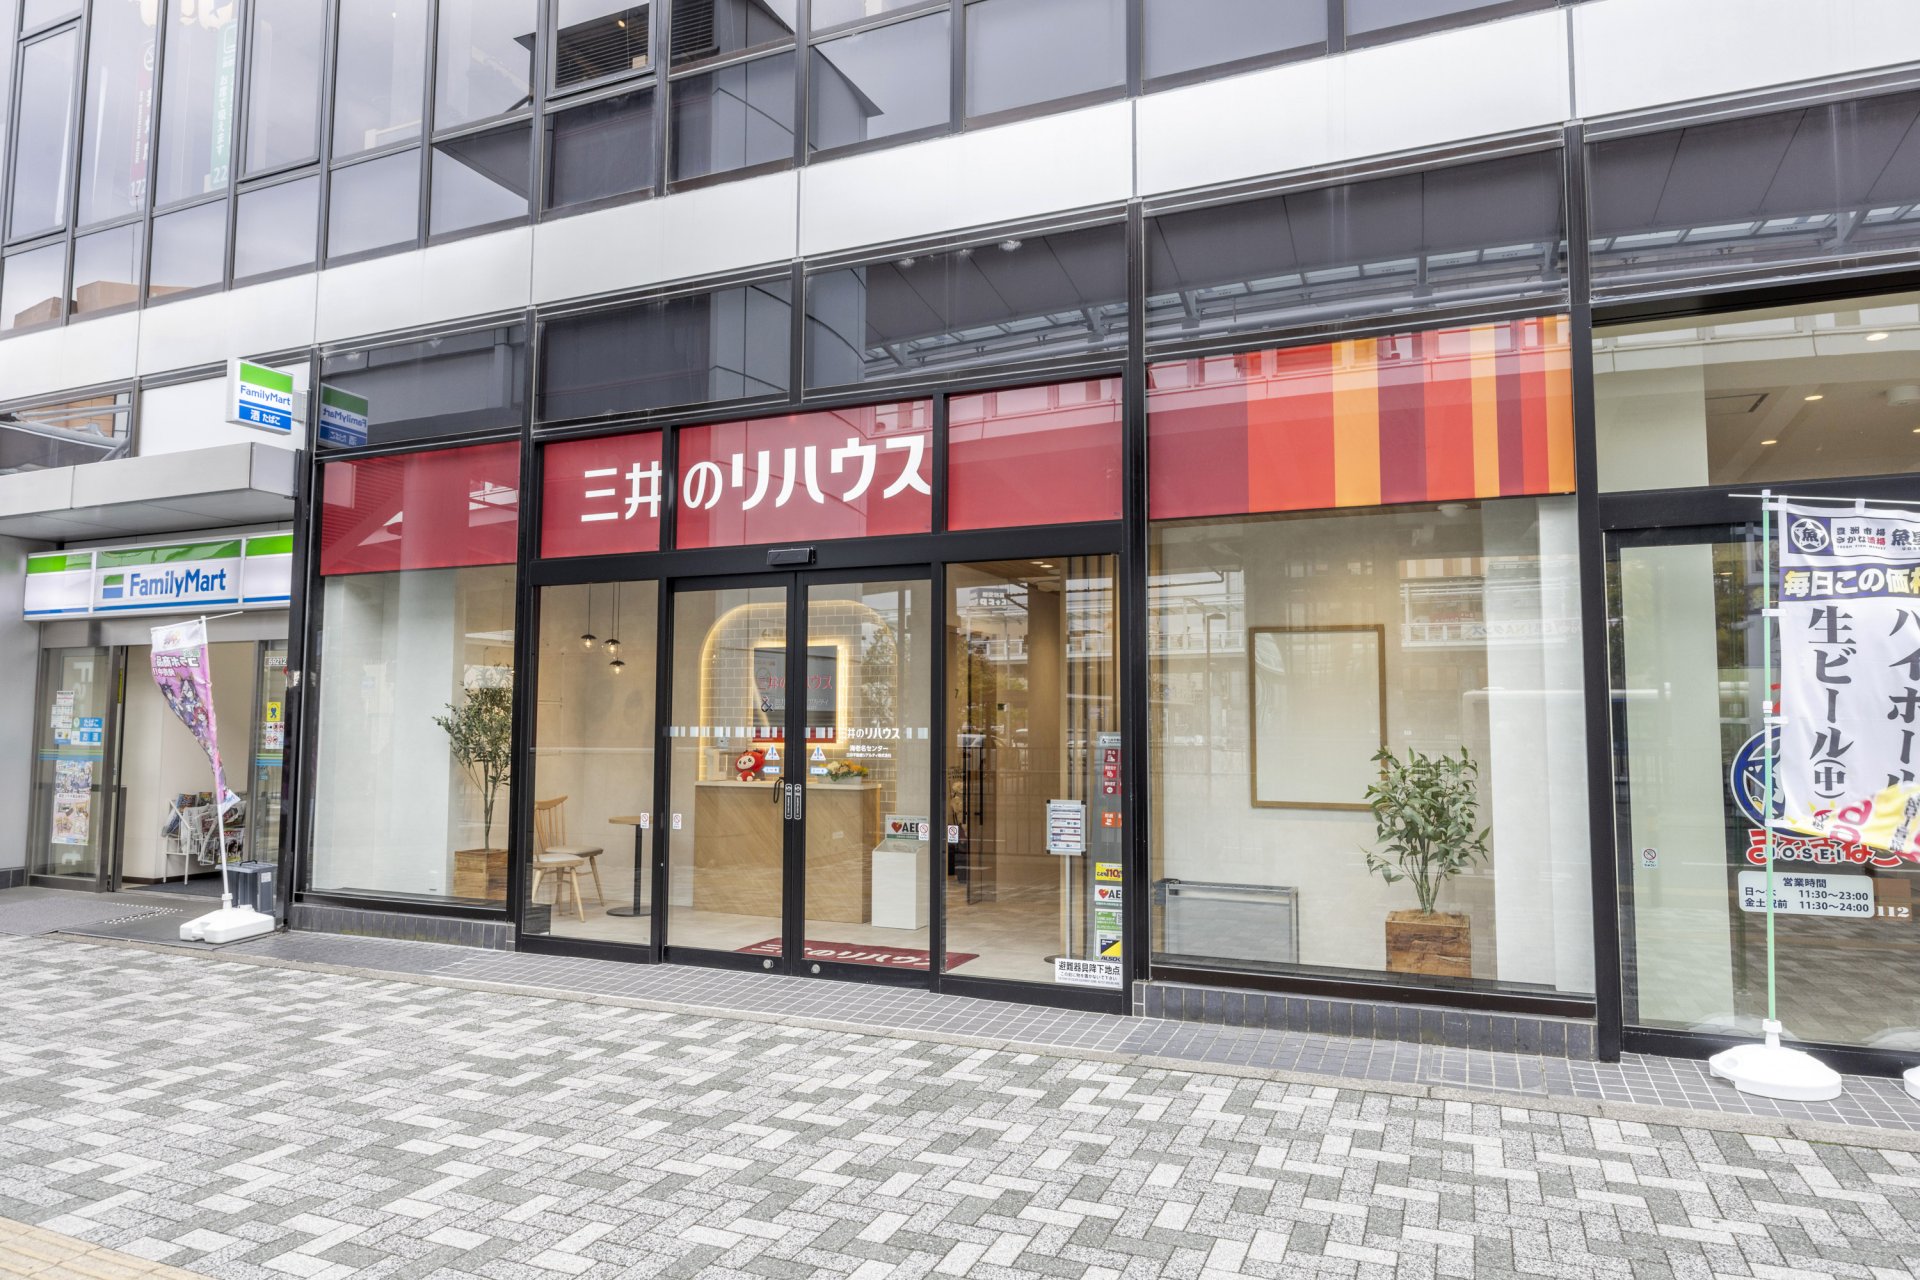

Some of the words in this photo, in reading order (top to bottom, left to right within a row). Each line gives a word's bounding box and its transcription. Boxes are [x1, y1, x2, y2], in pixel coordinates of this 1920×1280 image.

[240, 384, 291, 406] FamilyMart
[250, 409, 260, 421] 酒
[262, 413, 280, 426] たばこ
[581, 434, 932, 523] 三井のリハウス
[1801, 527, 1820, 543] 魚
[129, 568, 227, 598] FamilyMart
[83, 718, 99, 728] たばこ
[1769, 847, 1843, 861] OSEI
[1782, 876, 1827, 889] 営業時間
[1876, 906, 1910, 918] 112
[1058, 960, 1121, 976] 避難器具降下地点
